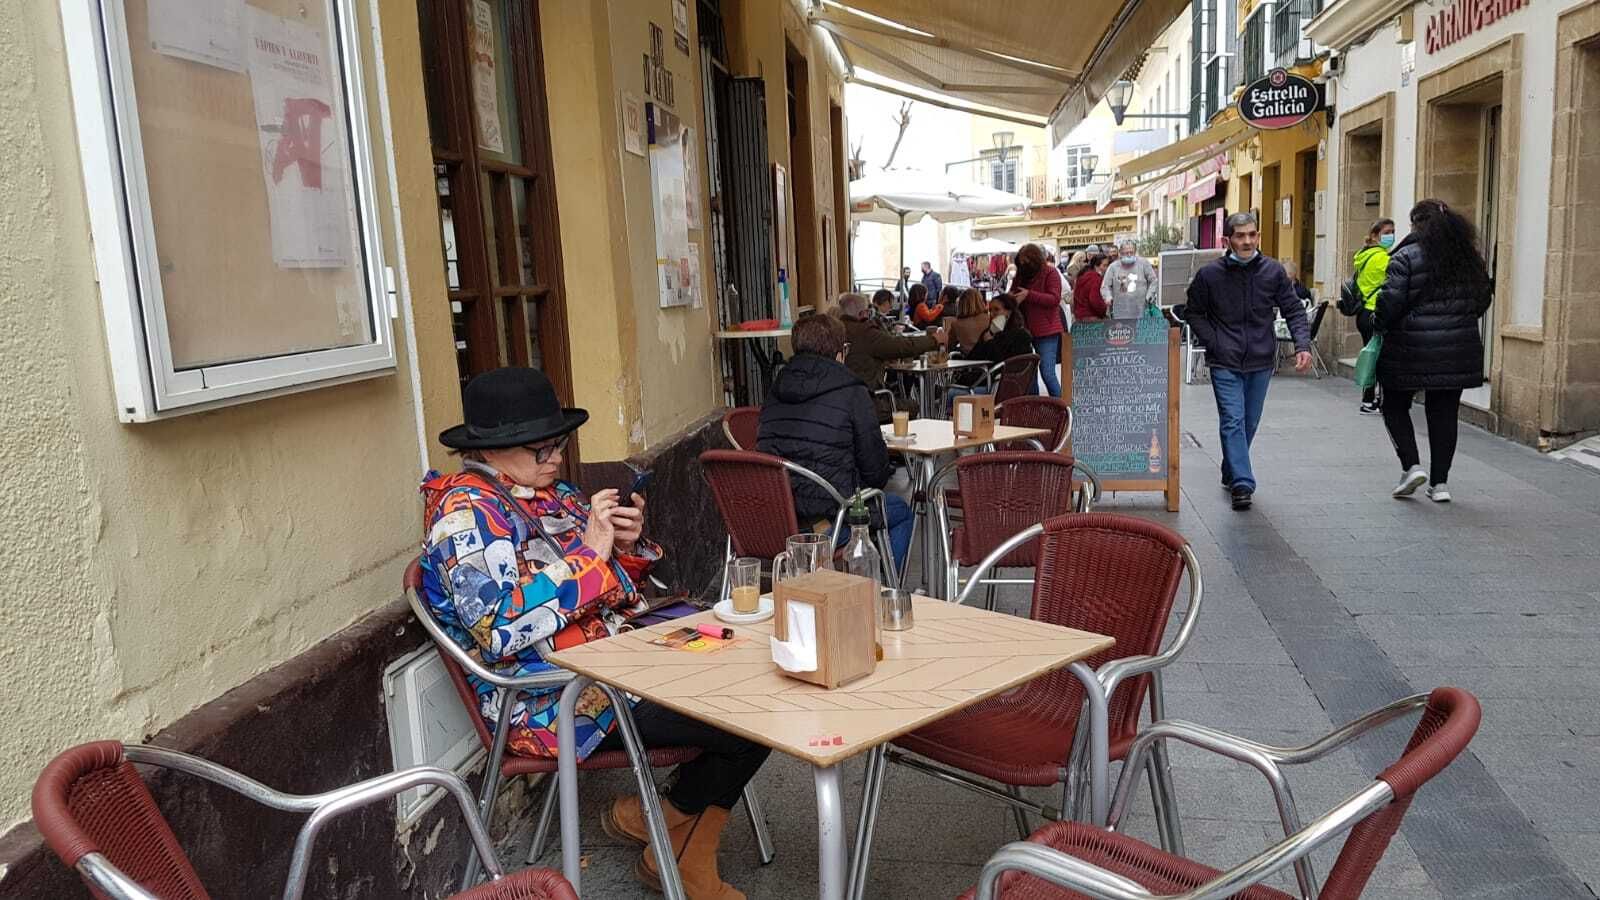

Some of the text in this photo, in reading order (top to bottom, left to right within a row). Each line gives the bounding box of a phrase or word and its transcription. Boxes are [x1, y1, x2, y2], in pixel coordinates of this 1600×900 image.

[1424, 0, 1522, 55] CARNICE
[1250, 85, 1308, 103] Estrella
[1252, 99, 1305, 118] Galicia
